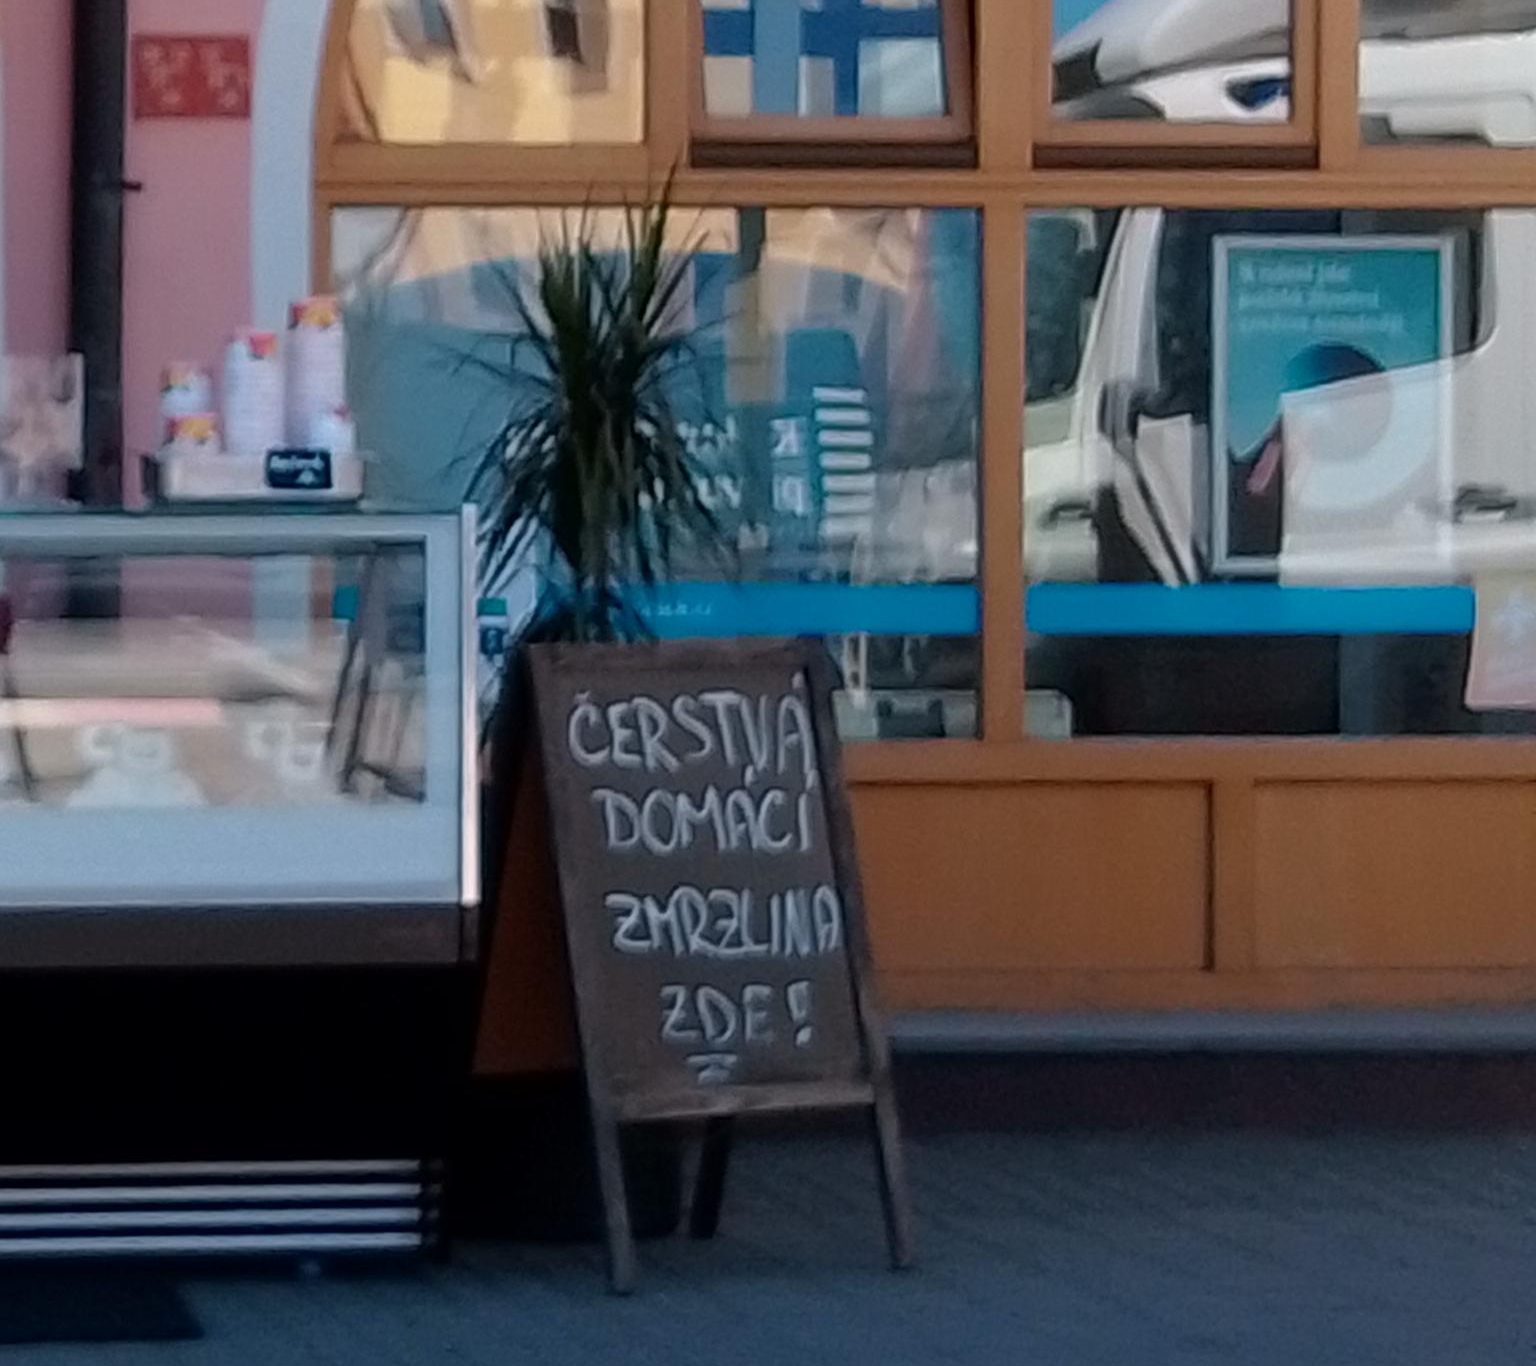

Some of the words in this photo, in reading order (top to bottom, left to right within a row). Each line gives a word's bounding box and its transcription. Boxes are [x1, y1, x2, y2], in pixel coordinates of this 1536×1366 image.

[568, 671, 814, 775] ČERSTVÁ
[590, 765, 818, 855] DOMÁCÍ
[604, 885, 844, 959] ZMRZLINA
